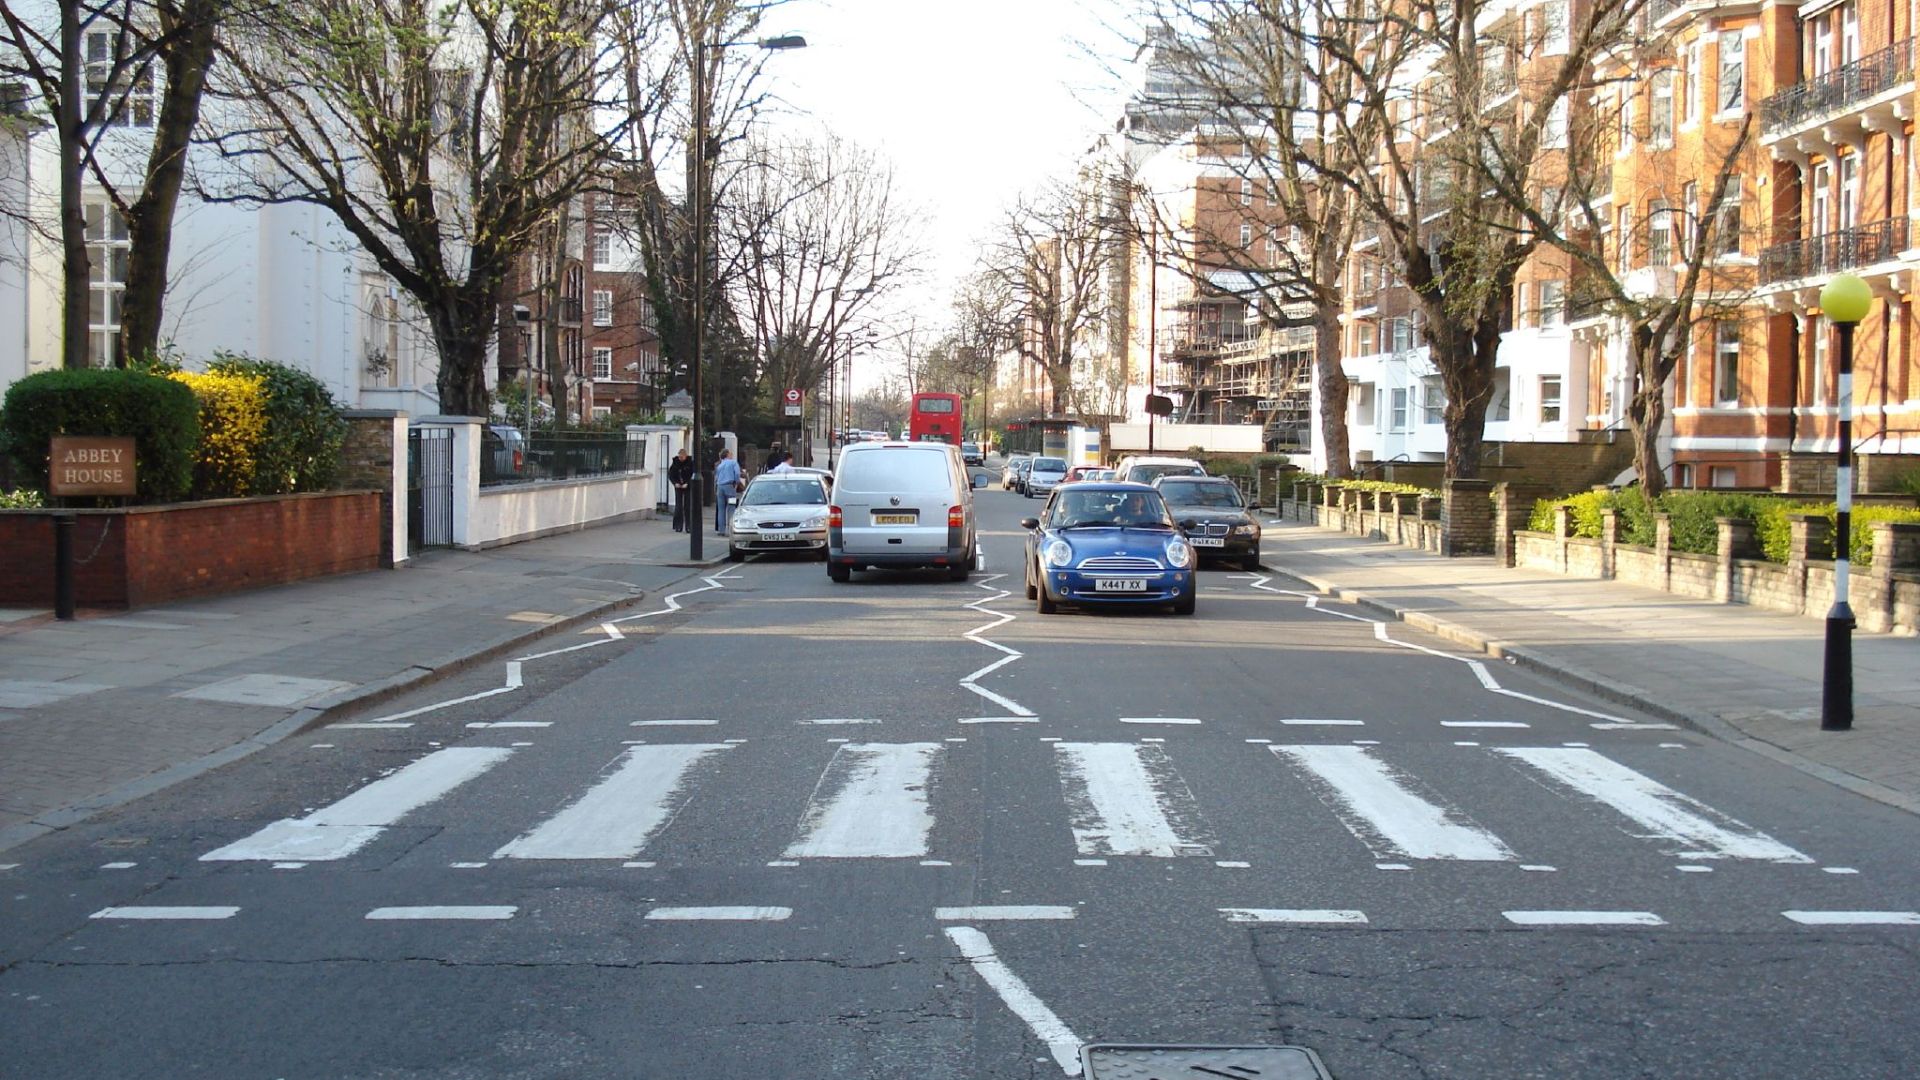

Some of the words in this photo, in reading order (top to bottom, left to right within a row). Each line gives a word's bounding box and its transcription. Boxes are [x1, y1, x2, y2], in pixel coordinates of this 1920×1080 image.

[64, 448, 122, 463] ABBEY
[65, 469, 123, 483] HOUSE
[1102, 581, 1126, 590] K44T
[1129, 581, 1141, 590] XX
